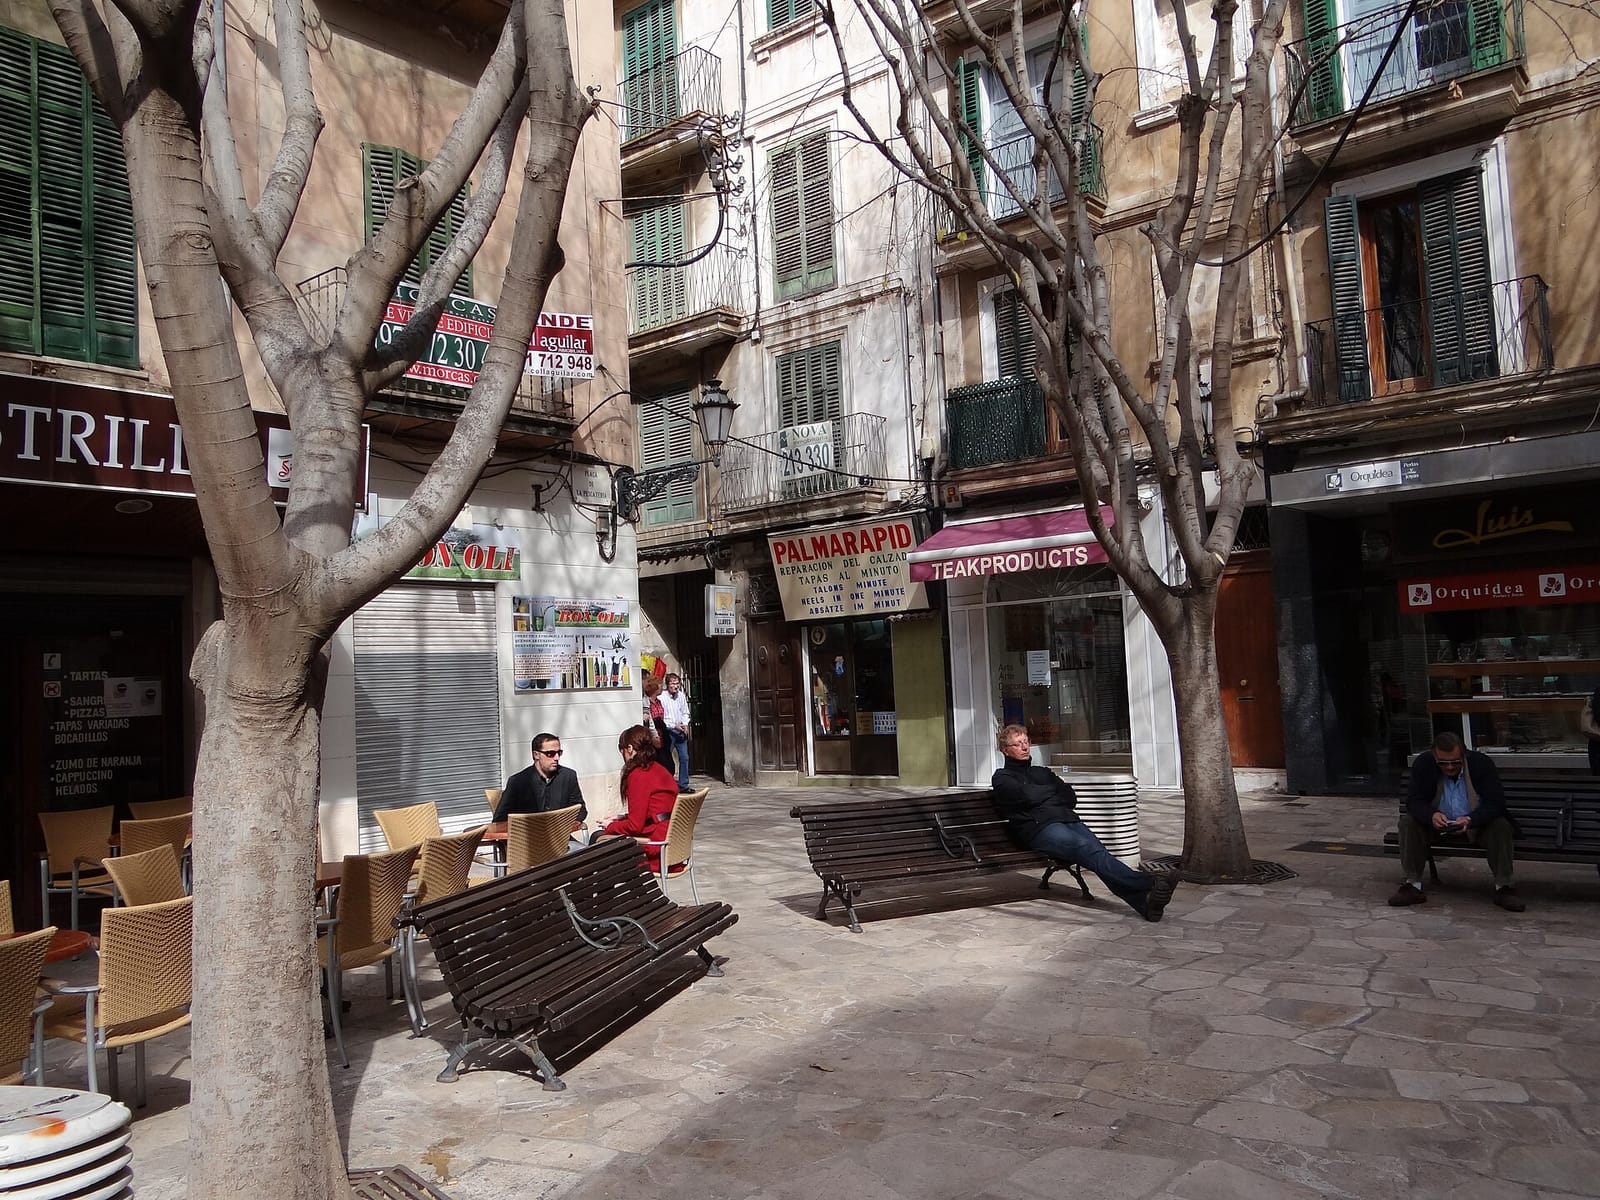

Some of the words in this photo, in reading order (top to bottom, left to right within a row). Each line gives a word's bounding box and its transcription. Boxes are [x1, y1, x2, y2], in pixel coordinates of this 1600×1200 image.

[446, 317, 493, 339] EDIFICI
[541, 313, 590, 329] NDE
[540, 334, 587, 352] aguilar
[538, 353, 563, 369] 712
[567, 356, 592, 371] 948
[0, 403, 192, 476] TRILL
[792, 424, 827, 440] NOVA
[805, 443, 830, 472] 330
[772, 523, 912, 565] PALMARAPID
[779, 560, 833, 577] REPARACION
[843, 558, 860, 568] DEL
[869, 551, 908, 565] CALZAD
[931, 546, 1088, 580] TEAKPRODUCTS
[798, 573, 829, 586] TAPAS
[839, 571, 850, 581] AL
[861, 565, 899, 578] MINUTO
[813, 583, 844, 594] TALONS
[856, 579, 887, 589] MINUTE
[832, 594, 842, 602] IN
[849, 590, 865, 600] ONE
[873, 587, 905, 598] MINUTE
[1435, 583, 1524, 600] Orquídea
[853, 602, 864, 611] IM
[874, 598, 901, 609] MINUT
[69, 671, 109, 681] TARTAS
[69, 696, 104, 707] SANGR
[69, 707, 106, 719] PIZZAS
[54, 720, 83, 732] TAPAS
[87, 718, 130, 730] VARIADAS
[54, 731, 109, 745] BOCADILLOS
[55, 759, 84, 771] ZUMO
[86, 757, 99, 768] DE
[101, 755, 143, 768] NARANJA
[55, 769, 113, 784] CAPPUCCINO
[55, 783, 98, 797] HELADOS
